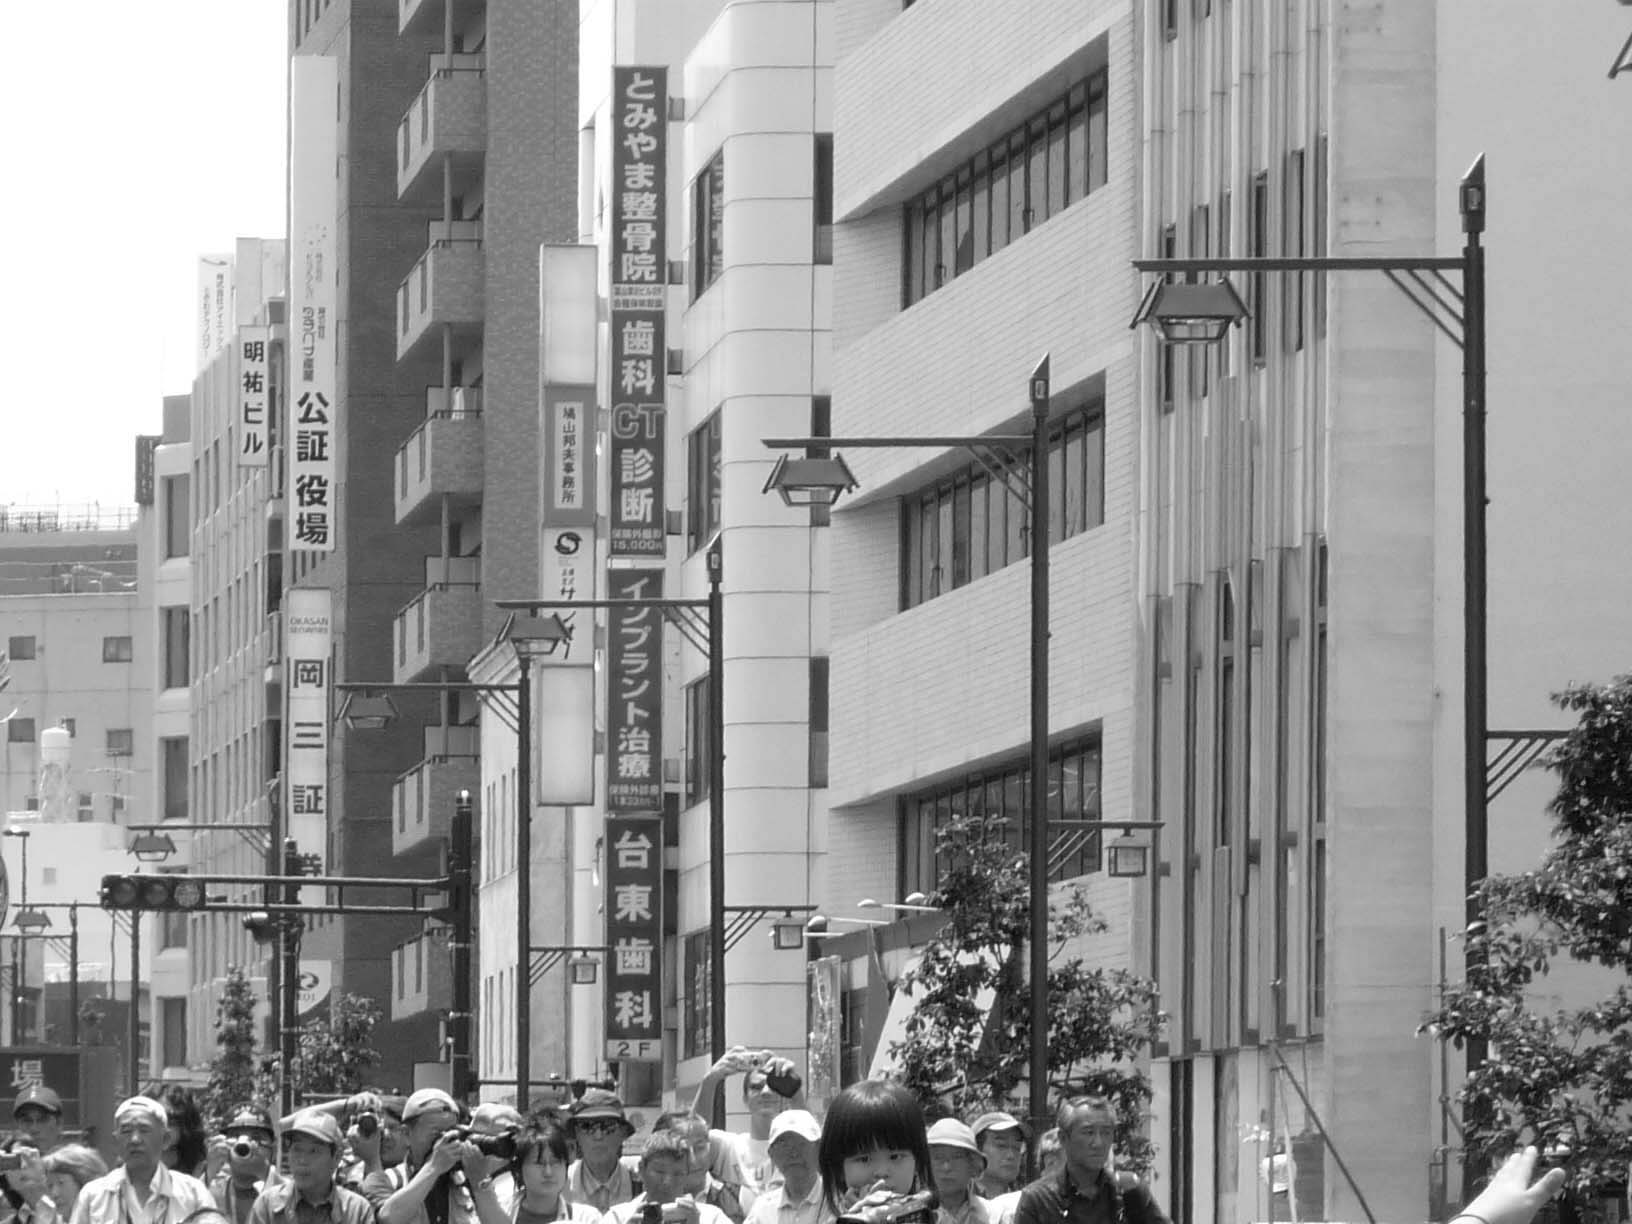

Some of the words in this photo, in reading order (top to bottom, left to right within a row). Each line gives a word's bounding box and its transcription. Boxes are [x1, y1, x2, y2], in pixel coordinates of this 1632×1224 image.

[621, 72, 658, 281] とみやま整骨院
[243, 341, 264, 455] 明祐ビル
[295, 391, 330, 545] 公証役場
[618, 576, 652, 779] インプラント治療
[613, 830, 654, 1030] 台東歯科
[616, 1041, 652, 1058] 2F
